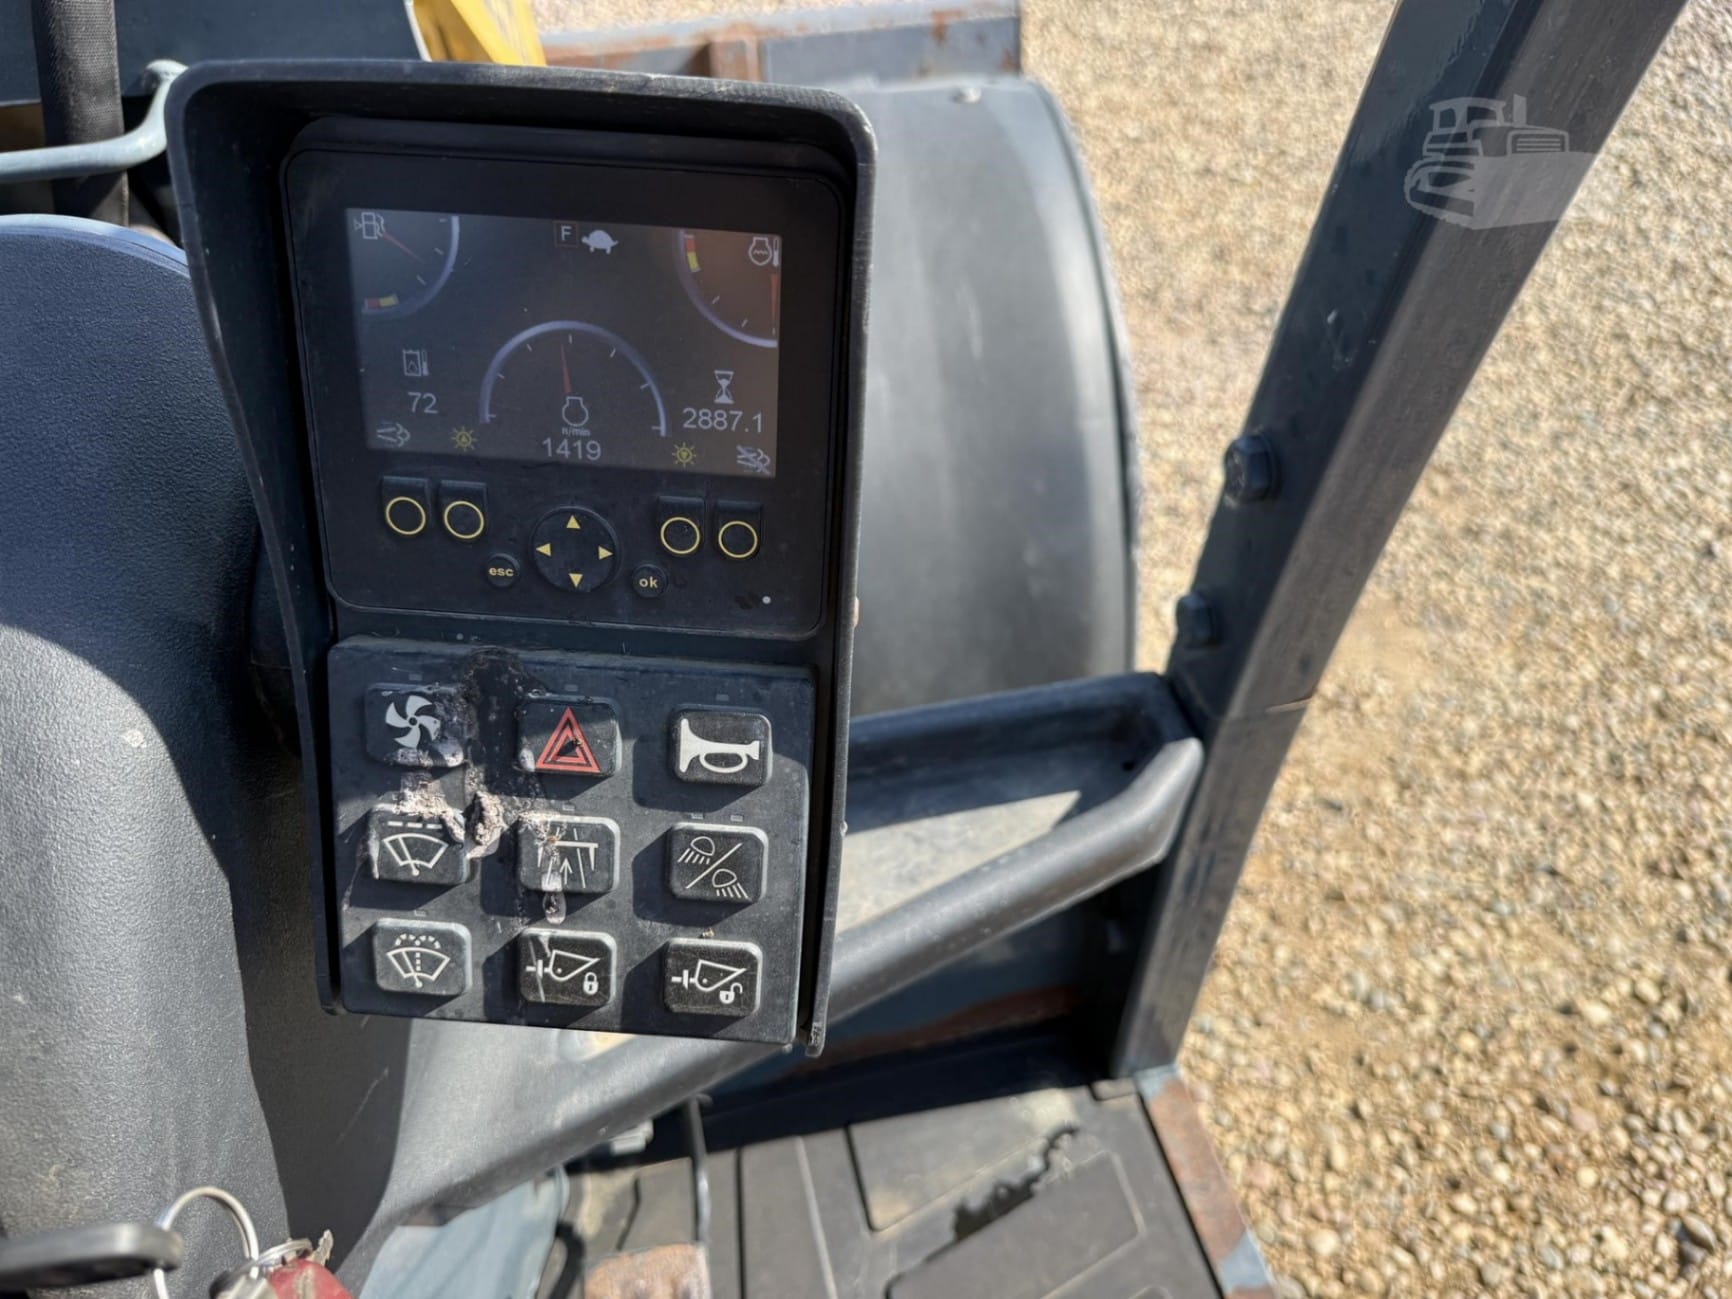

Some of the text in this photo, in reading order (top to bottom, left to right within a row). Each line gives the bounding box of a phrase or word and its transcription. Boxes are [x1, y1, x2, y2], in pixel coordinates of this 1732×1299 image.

[561, 225, 572, 241] F
[407, 391, 438, 414] 72
[682, 407, 762, 433] 2887.1
[542, 437, 602, 461] 1419
[488, 566, 515, 578] esc
[638, 575, 659, 589] ok
